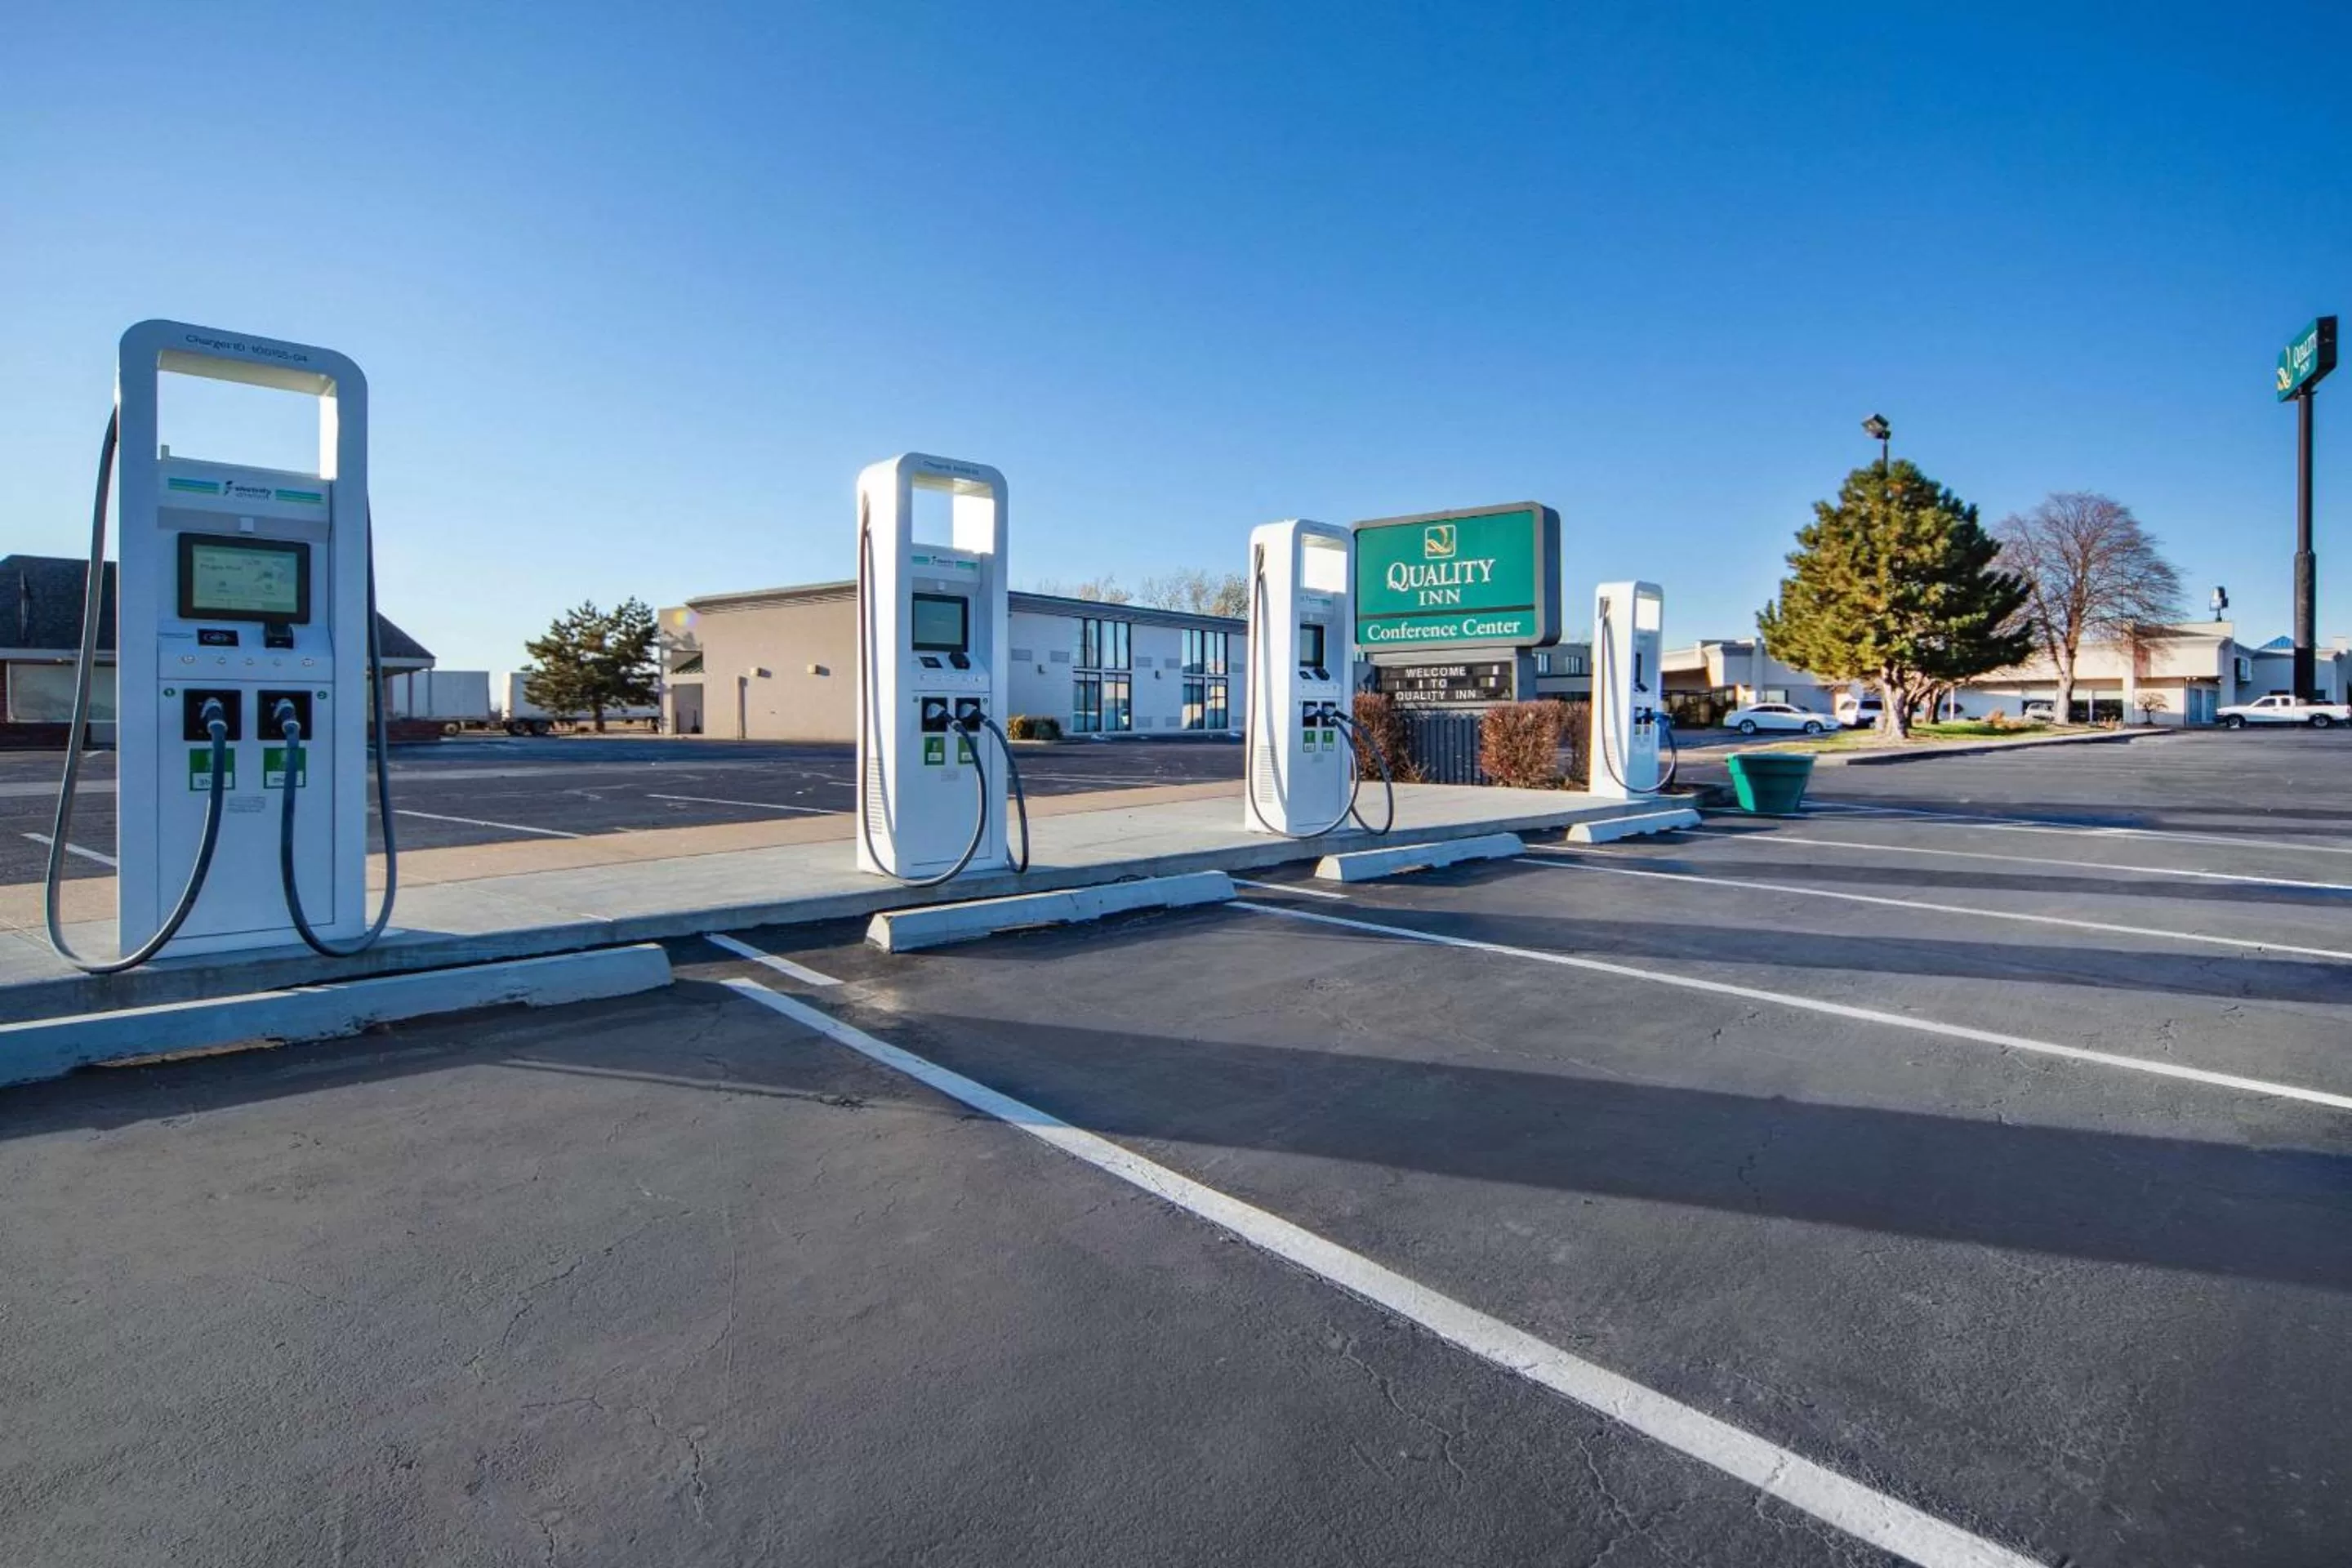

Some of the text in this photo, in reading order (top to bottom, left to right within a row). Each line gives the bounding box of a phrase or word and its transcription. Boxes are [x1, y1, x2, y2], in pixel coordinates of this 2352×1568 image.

[1388, 559, 1496, 591] QUALITY
[1418, 589, 1461, 606] INN
[1368, 618, 1521, 640] Conference Center
[1405, 666, 1467, 678] WELCOME
[1430, 679, 1448, 688] TO
[1395, 689, 1477, 702] QUALITY INN
